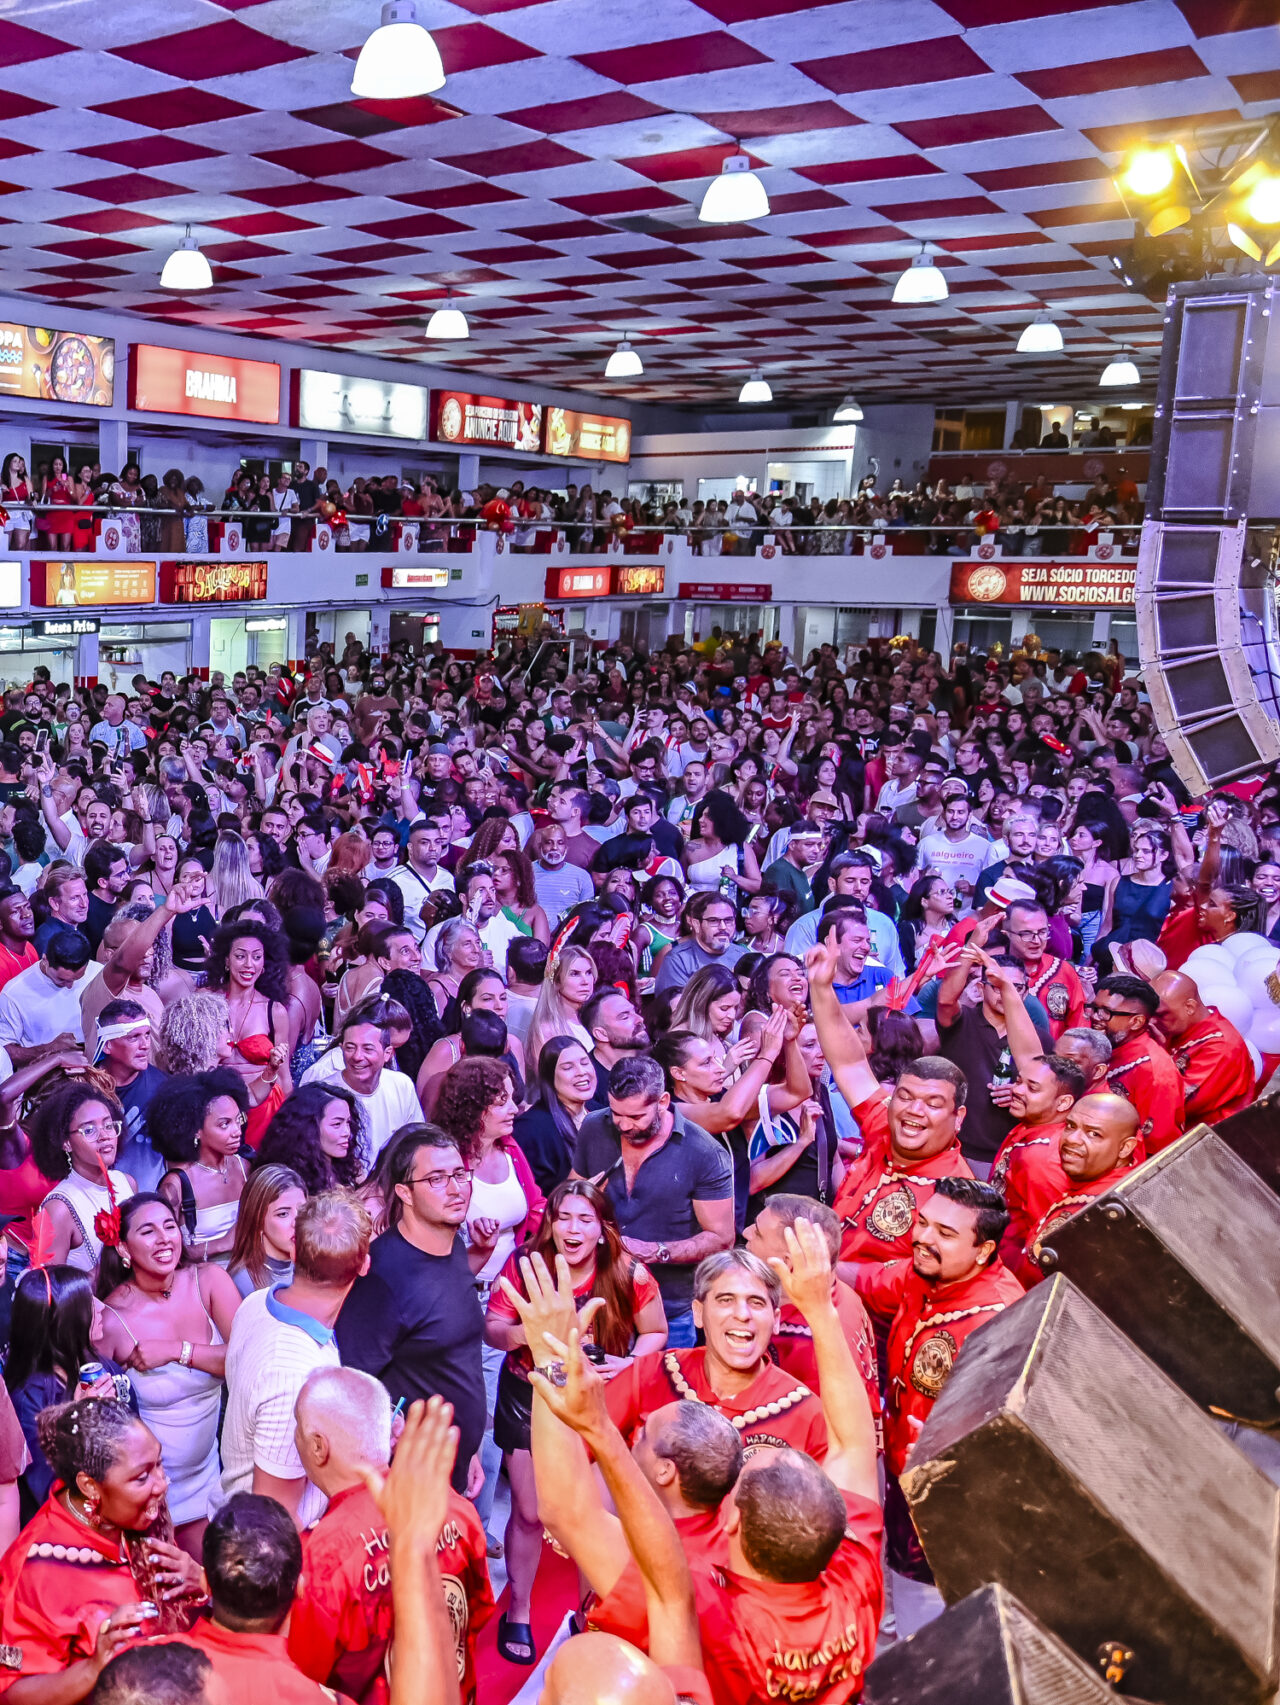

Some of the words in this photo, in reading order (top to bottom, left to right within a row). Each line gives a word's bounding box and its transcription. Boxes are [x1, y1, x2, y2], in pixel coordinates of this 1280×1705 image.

[185, 369, 237, 404] BRAHMA
[464, 417, 497, 440] ANUNCIE
[1021, 568, 1048, 583] SEJA
[1049, 565, 1084, 583] SÓCIO
[1085, 569, 1137, 583] TORCEDO
